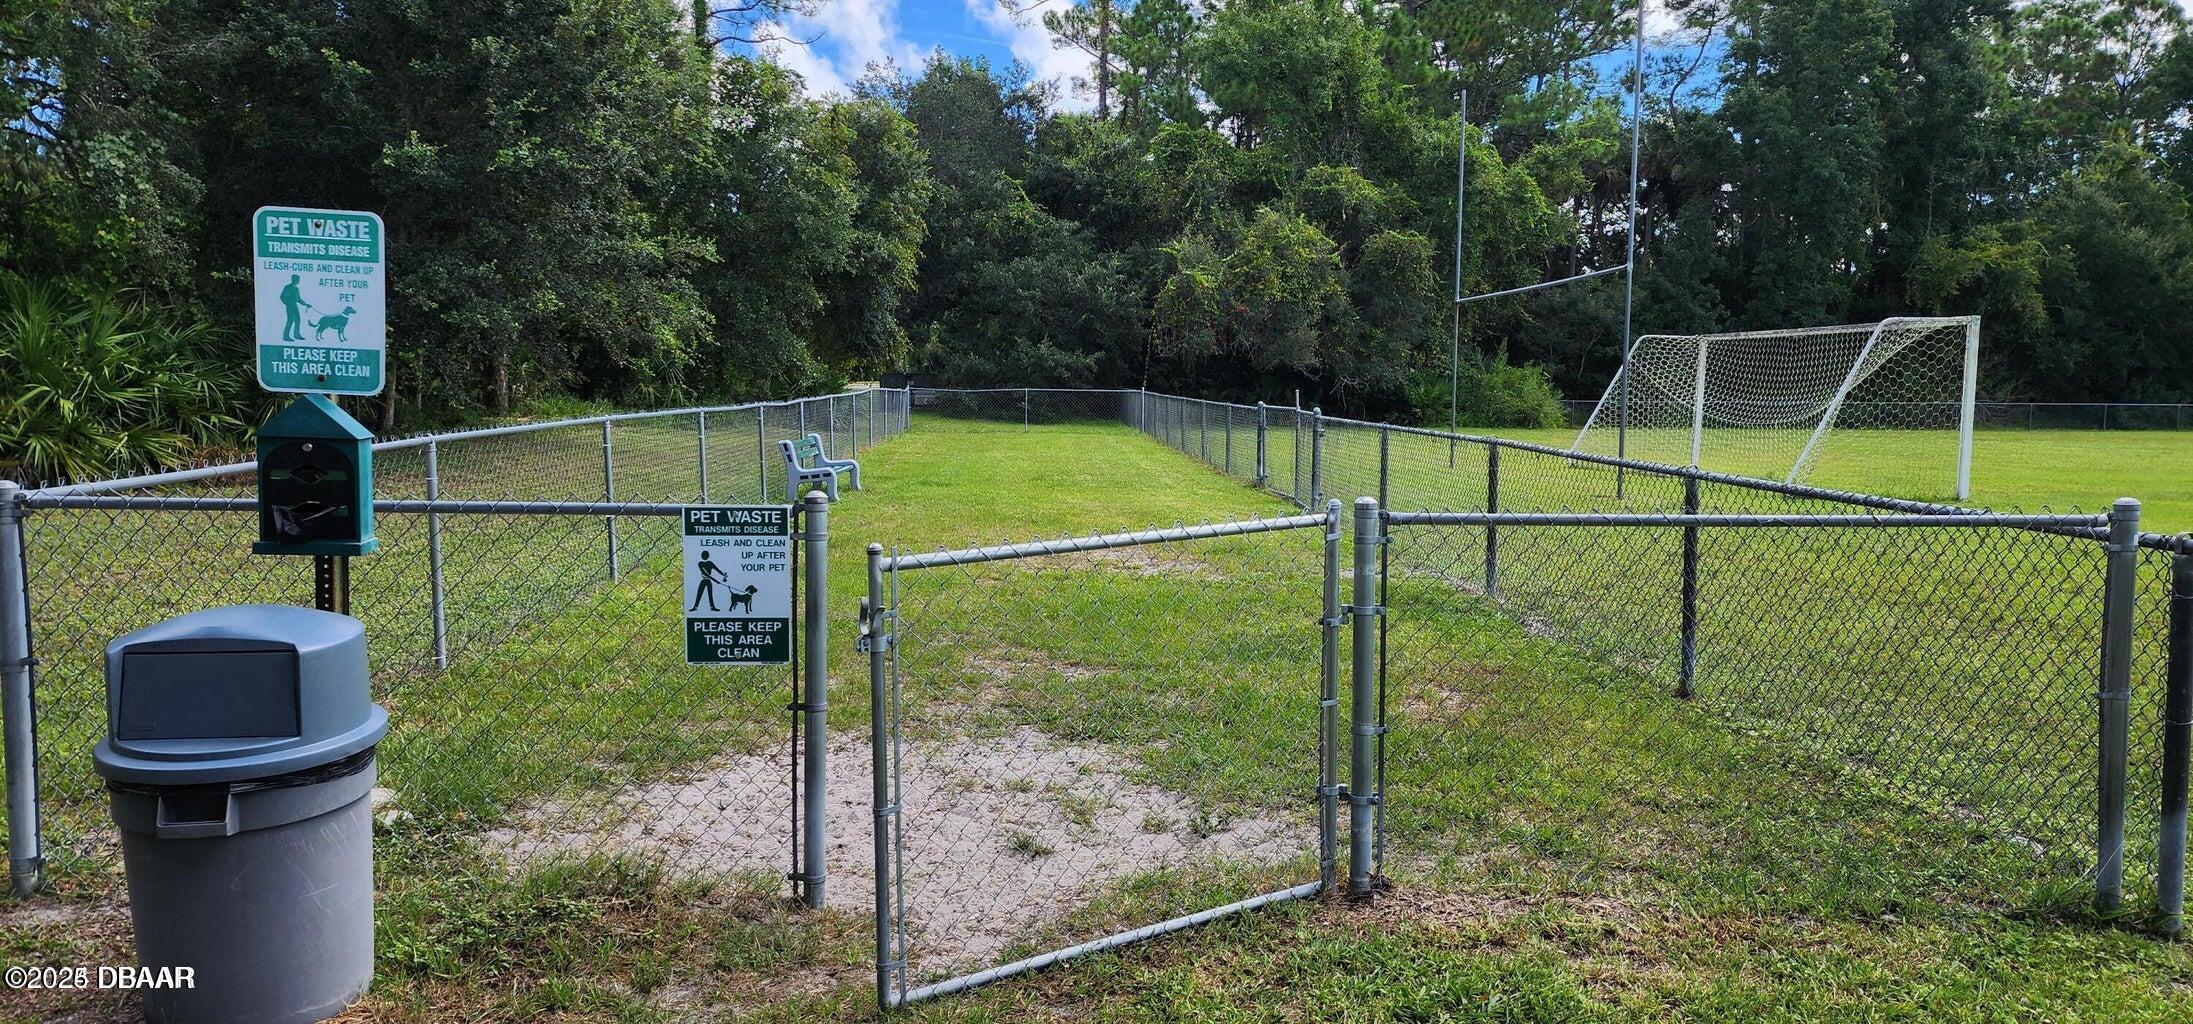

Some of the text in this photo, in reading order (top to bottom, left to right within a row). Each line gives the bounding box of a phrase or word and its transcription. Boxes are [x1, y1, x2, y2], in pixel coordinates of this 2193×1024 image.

[266, 217, 370, 239] PET WASTE
[268, 241, 370, 257] TRANSMITS DISEASE
[264, 261, 374, 275] LEASH-CURB AND CLEAN UP
[319, 279, 368, 289] AFTER YOUR
[339, 294, 356, 302] PET
[283, 348, 358, 362] PLEASE KEEP
[272, 362, 370, 377] THIS AREA CLEAN
[691, 511, 782, 523] PET WASTE
[741, 564, 765, 572] YOUR
[694, 622, 782, 632] PLEASE KEEP
[704, 635, 772, 645] THIS AREA
[718, 648, 759, 658] CLEAN
